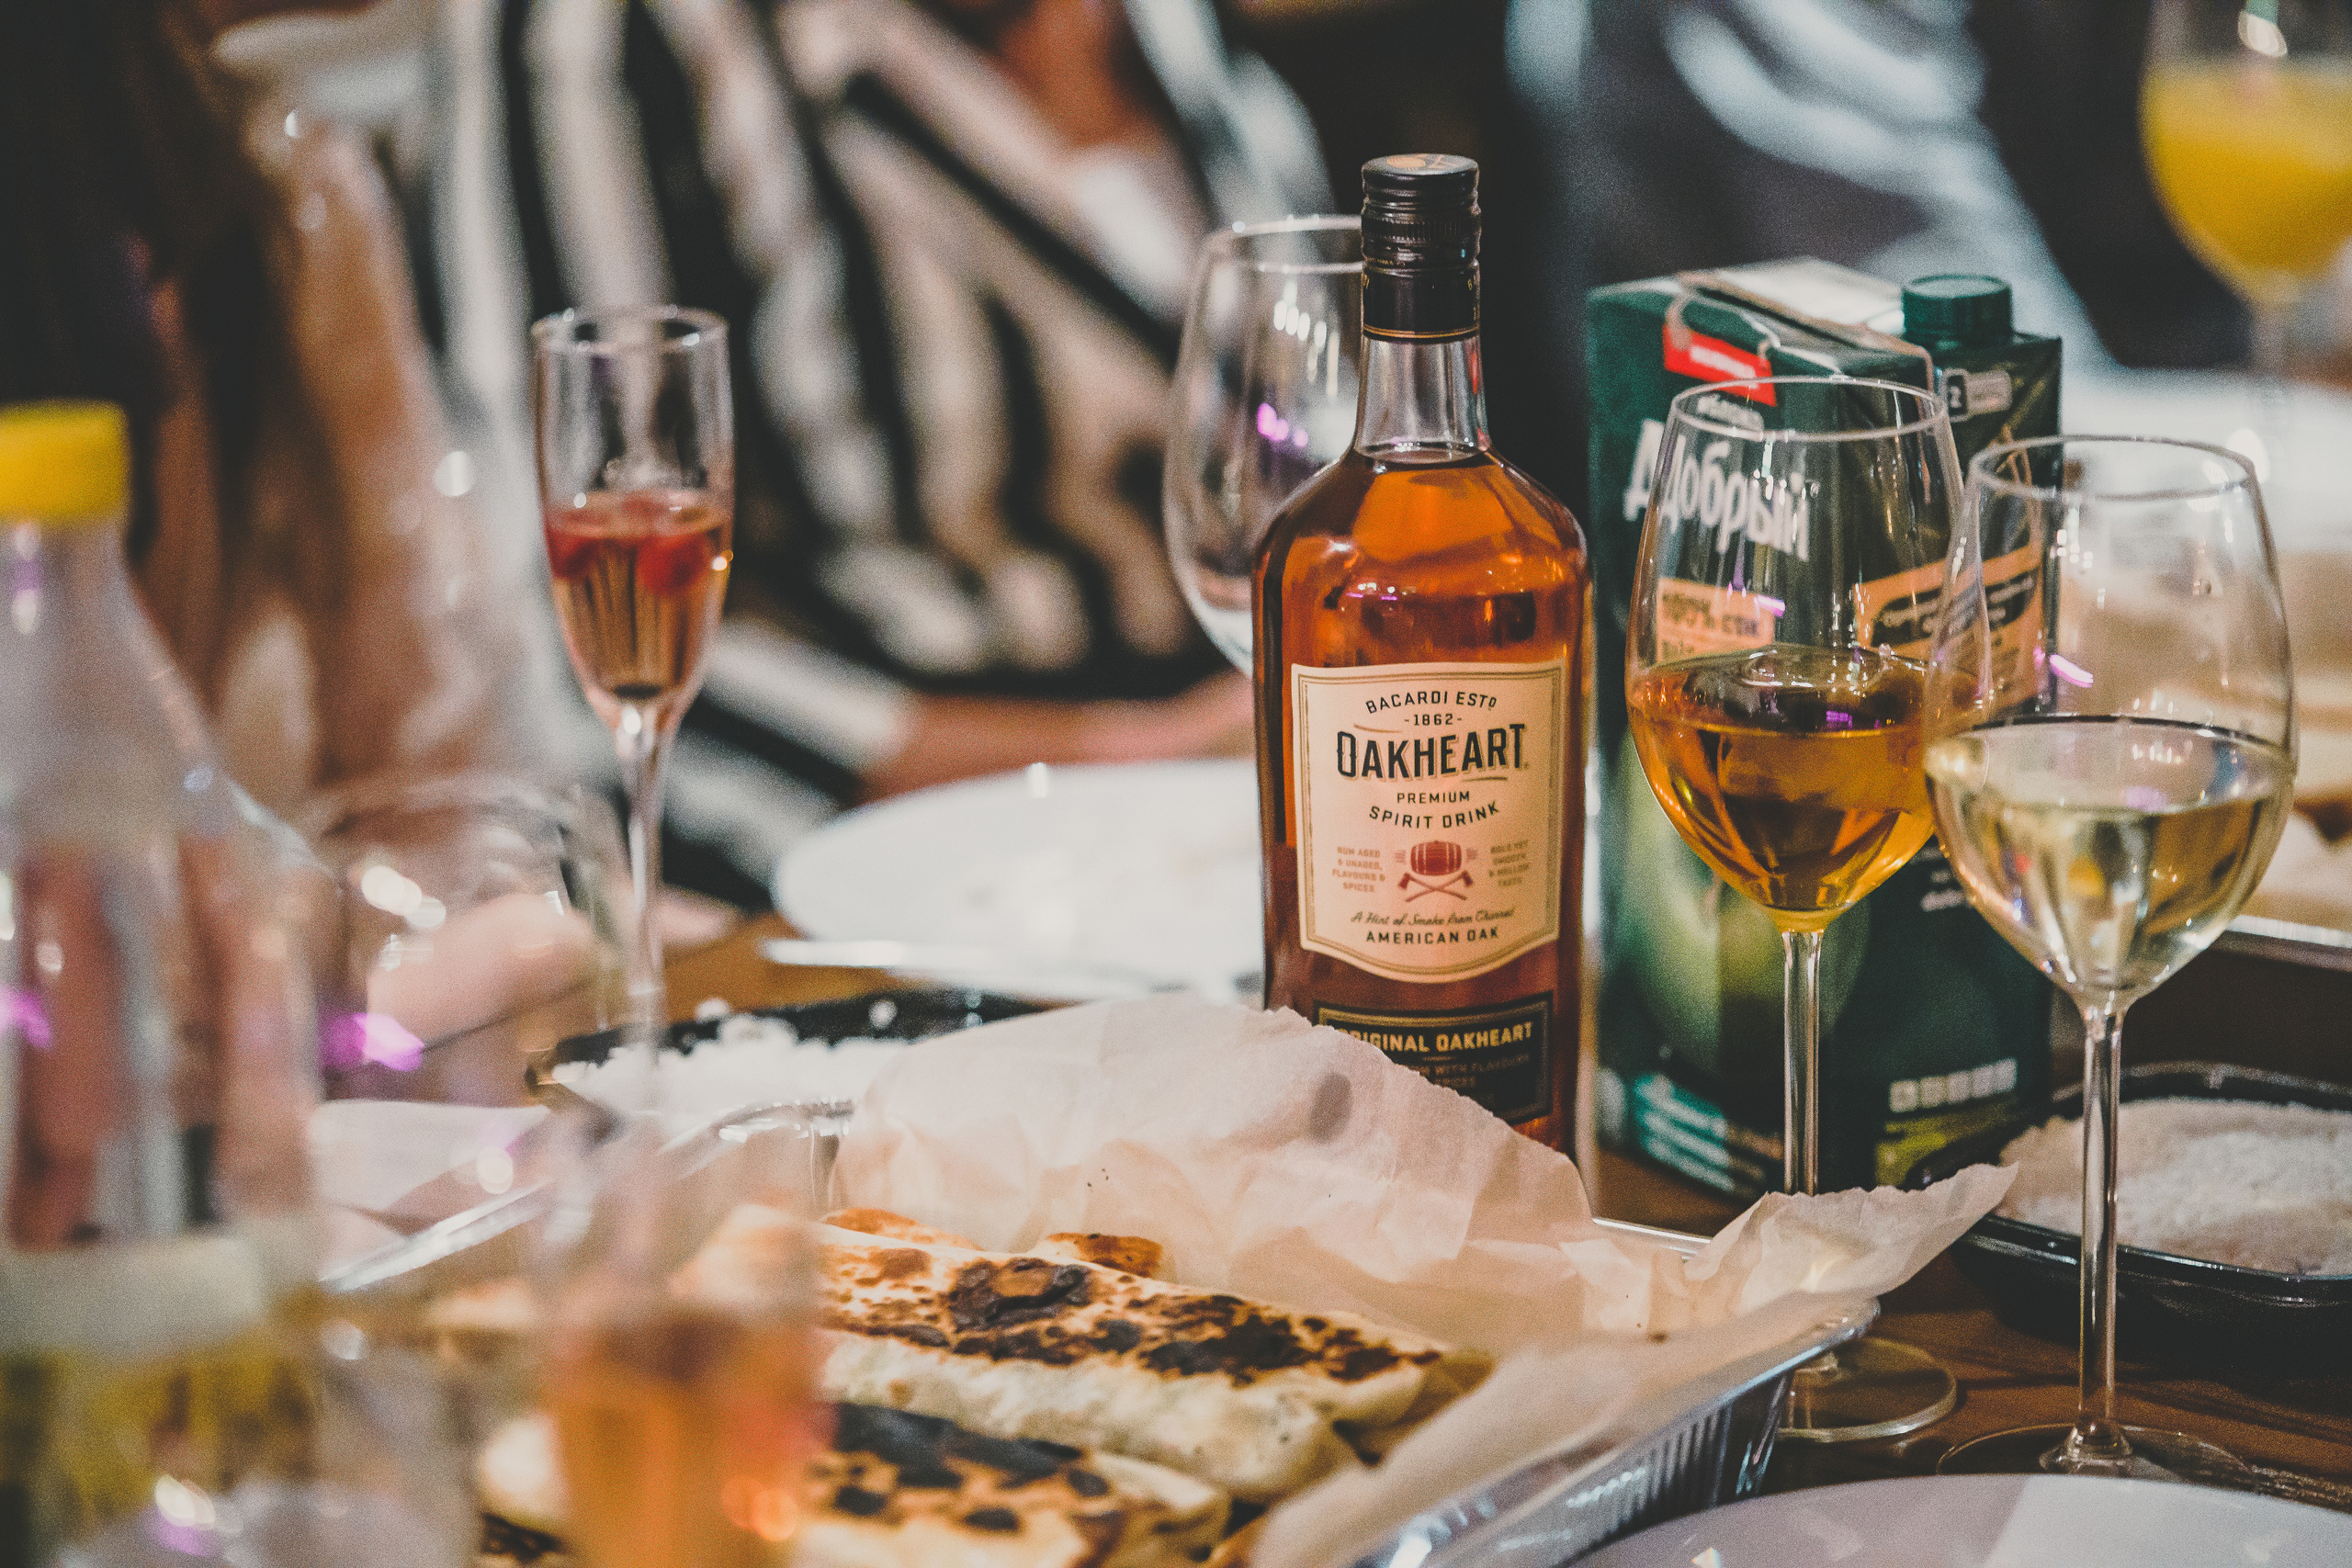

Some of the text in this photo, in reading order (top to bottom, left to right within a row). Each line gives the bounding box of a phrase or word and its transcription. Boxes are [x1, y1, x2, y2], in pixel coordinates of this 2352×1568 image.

[1365, 691, 1448, 714] BACARDI
[1337, 724, 1525, 778] OAKHEART
[1396, 790, 1470, 804] PREMIUM
[1369, 800, 1499, 829] SPIRIT DRINK
[1366, 926, 1498, 944] AMERICAN OAK
[1337, 1021, 1533, 1053] IGINAL OAKHEART
